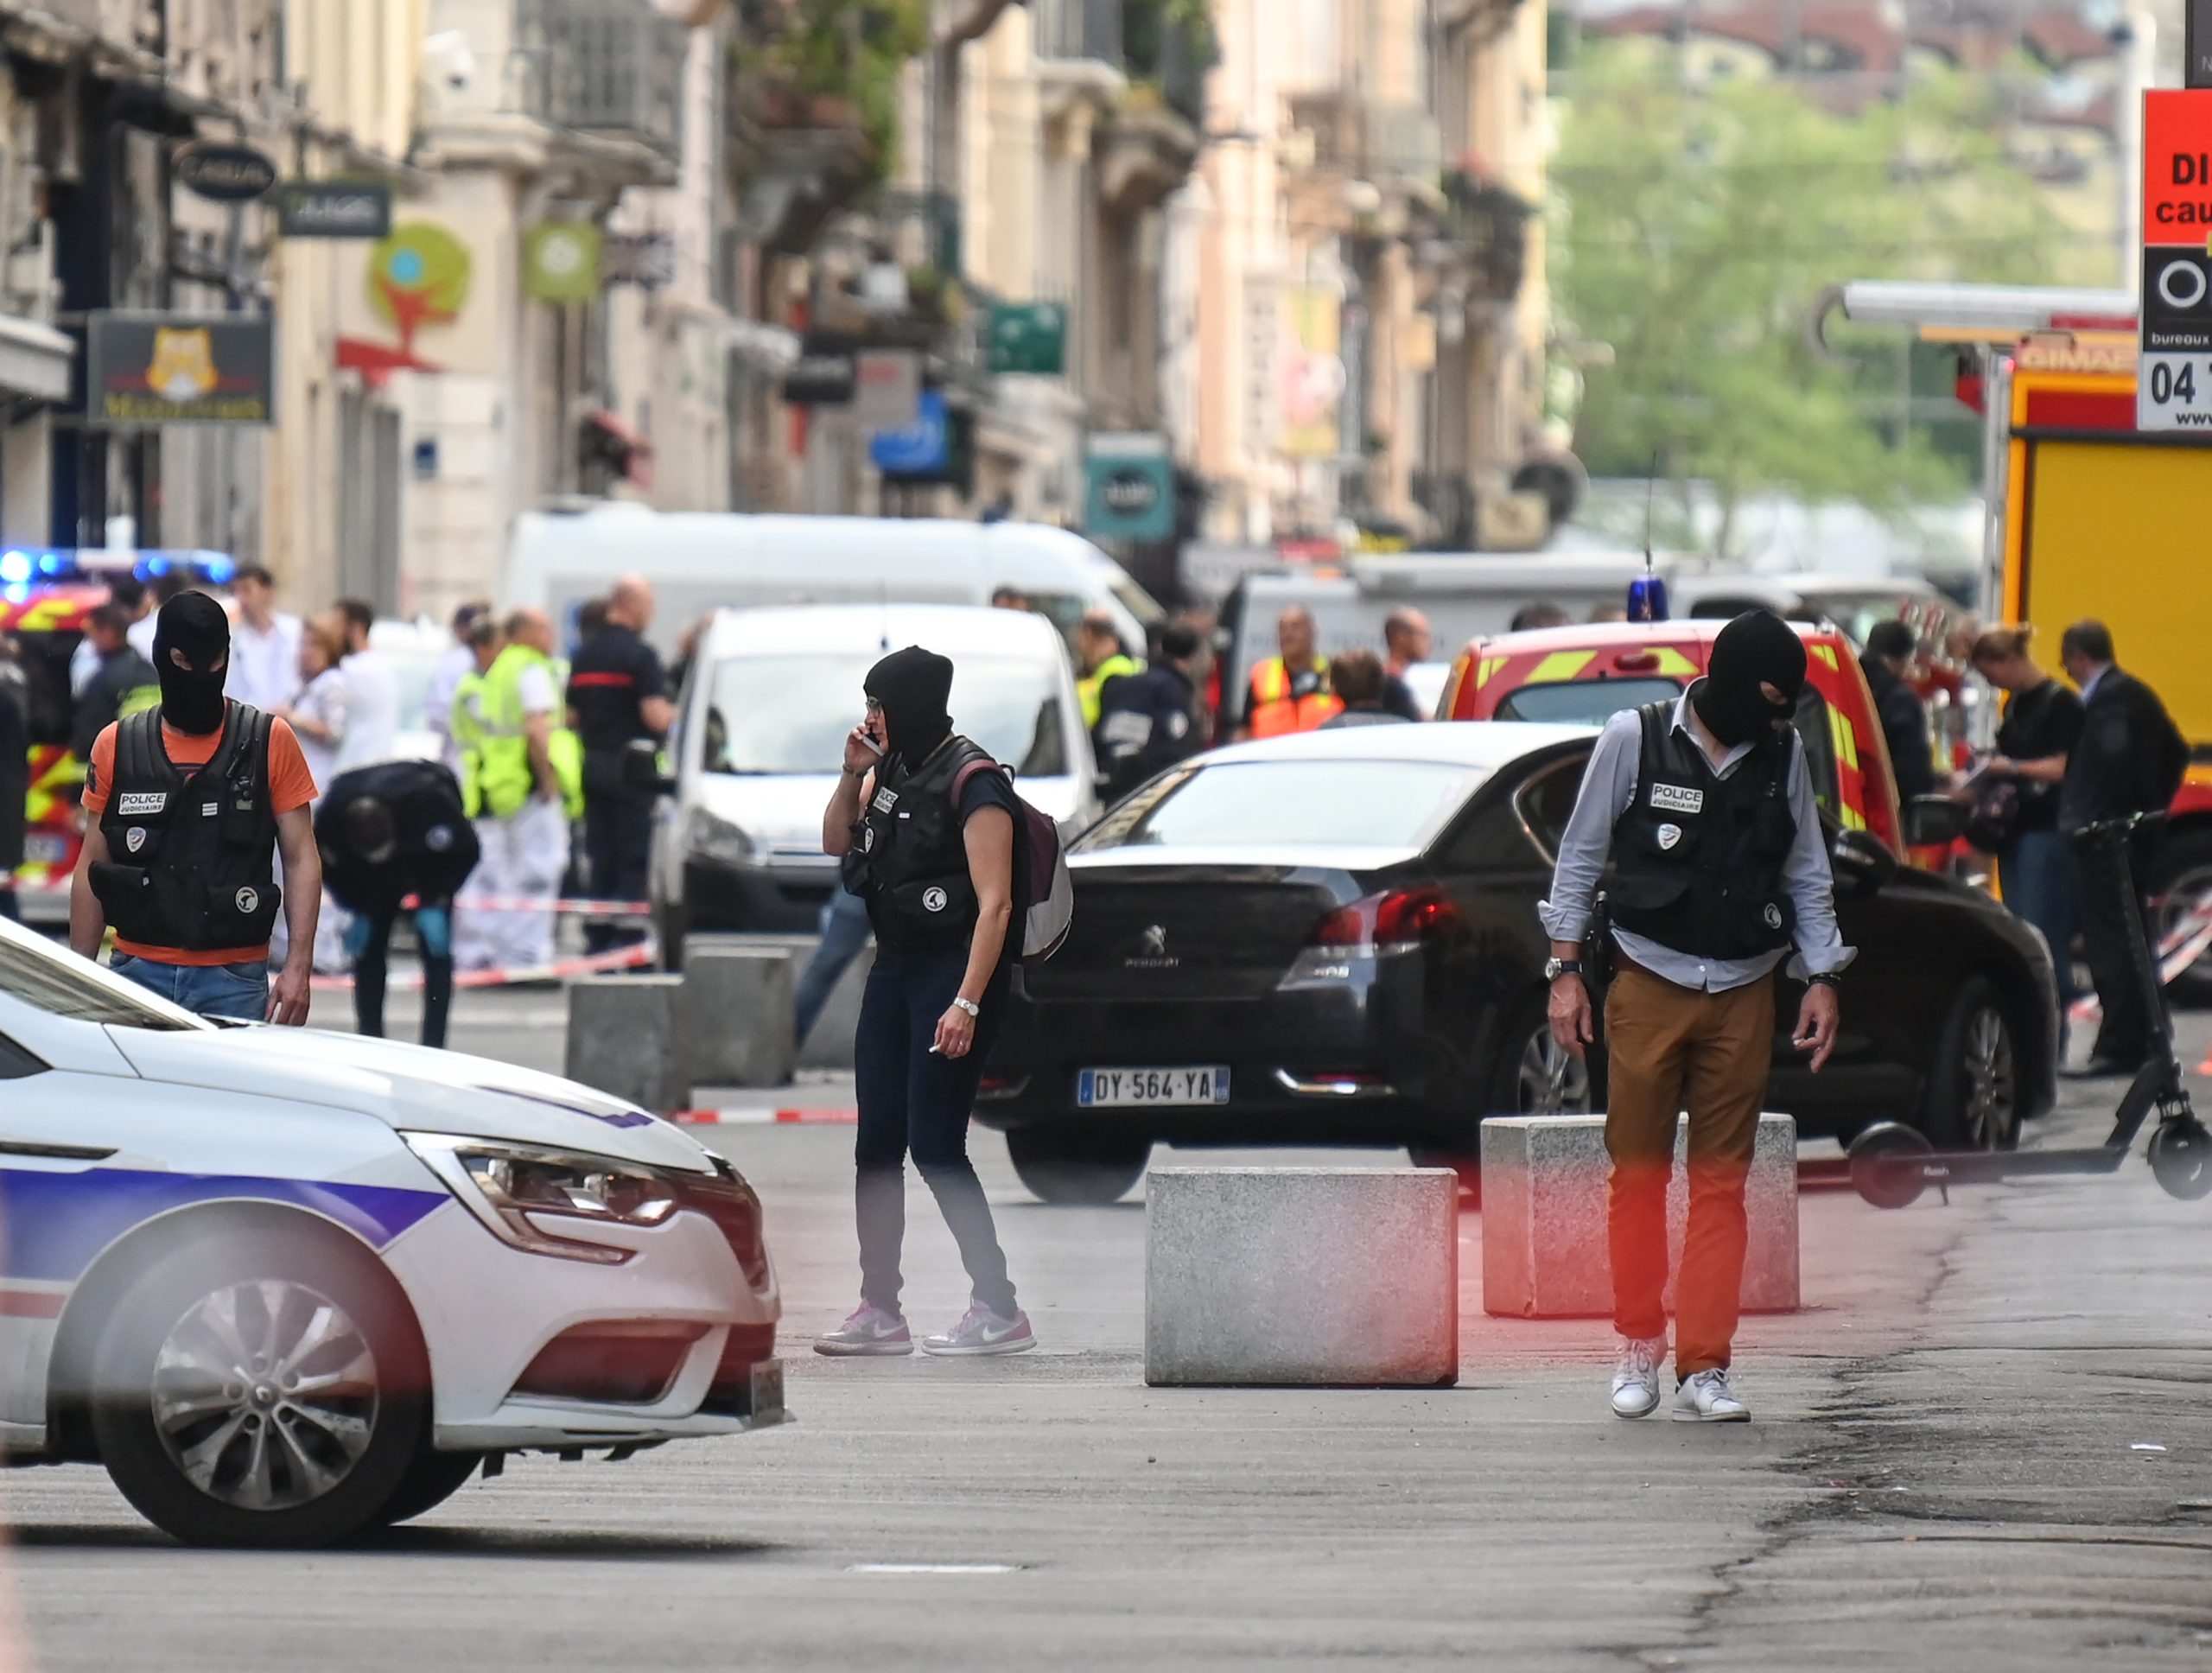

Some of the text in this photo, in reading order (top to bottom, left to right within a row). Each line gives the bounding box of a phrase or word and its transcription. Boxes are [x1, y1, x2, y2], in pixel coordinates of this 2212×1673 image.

[2172, 153, 2212, 185] DI
[2152, 331, 2209, 346] bureaux
[2152, 361, 2196, 404] 04
[121, 794, 164, 805] POLICE
[1654, 786, 1702, 802] POLICE
[120, 804, 162, 812] JUDICIAIRE
[1653, 798, 1700, 811] JUDICIAIRE
